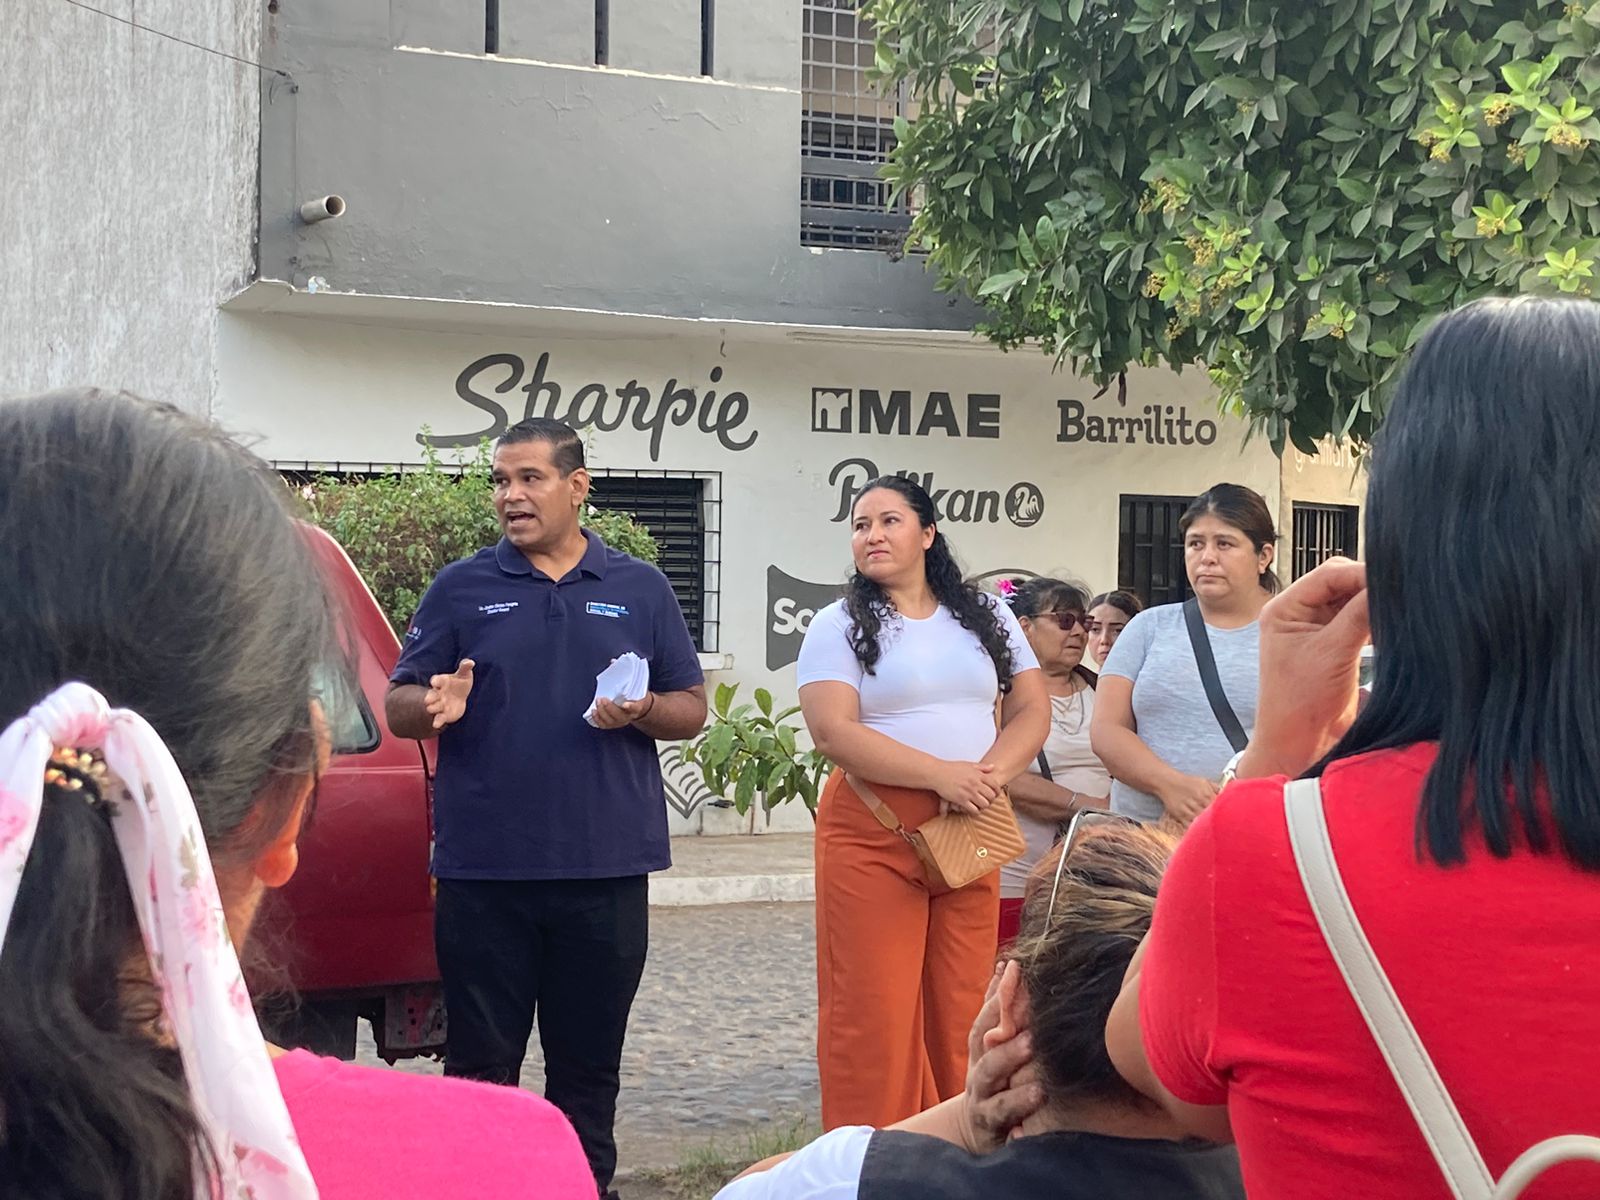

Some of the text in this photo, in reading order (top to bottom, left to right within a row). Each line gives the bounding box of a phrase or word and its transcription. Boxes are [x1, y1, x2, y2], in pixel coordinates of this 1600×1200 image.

[416, 352, 758, 461] Sharpie
[859, 389, 1001, 439] MAE
[1057, 399, 1217, 446] Barrilito
[829, 458, 999, 523] Pkan
